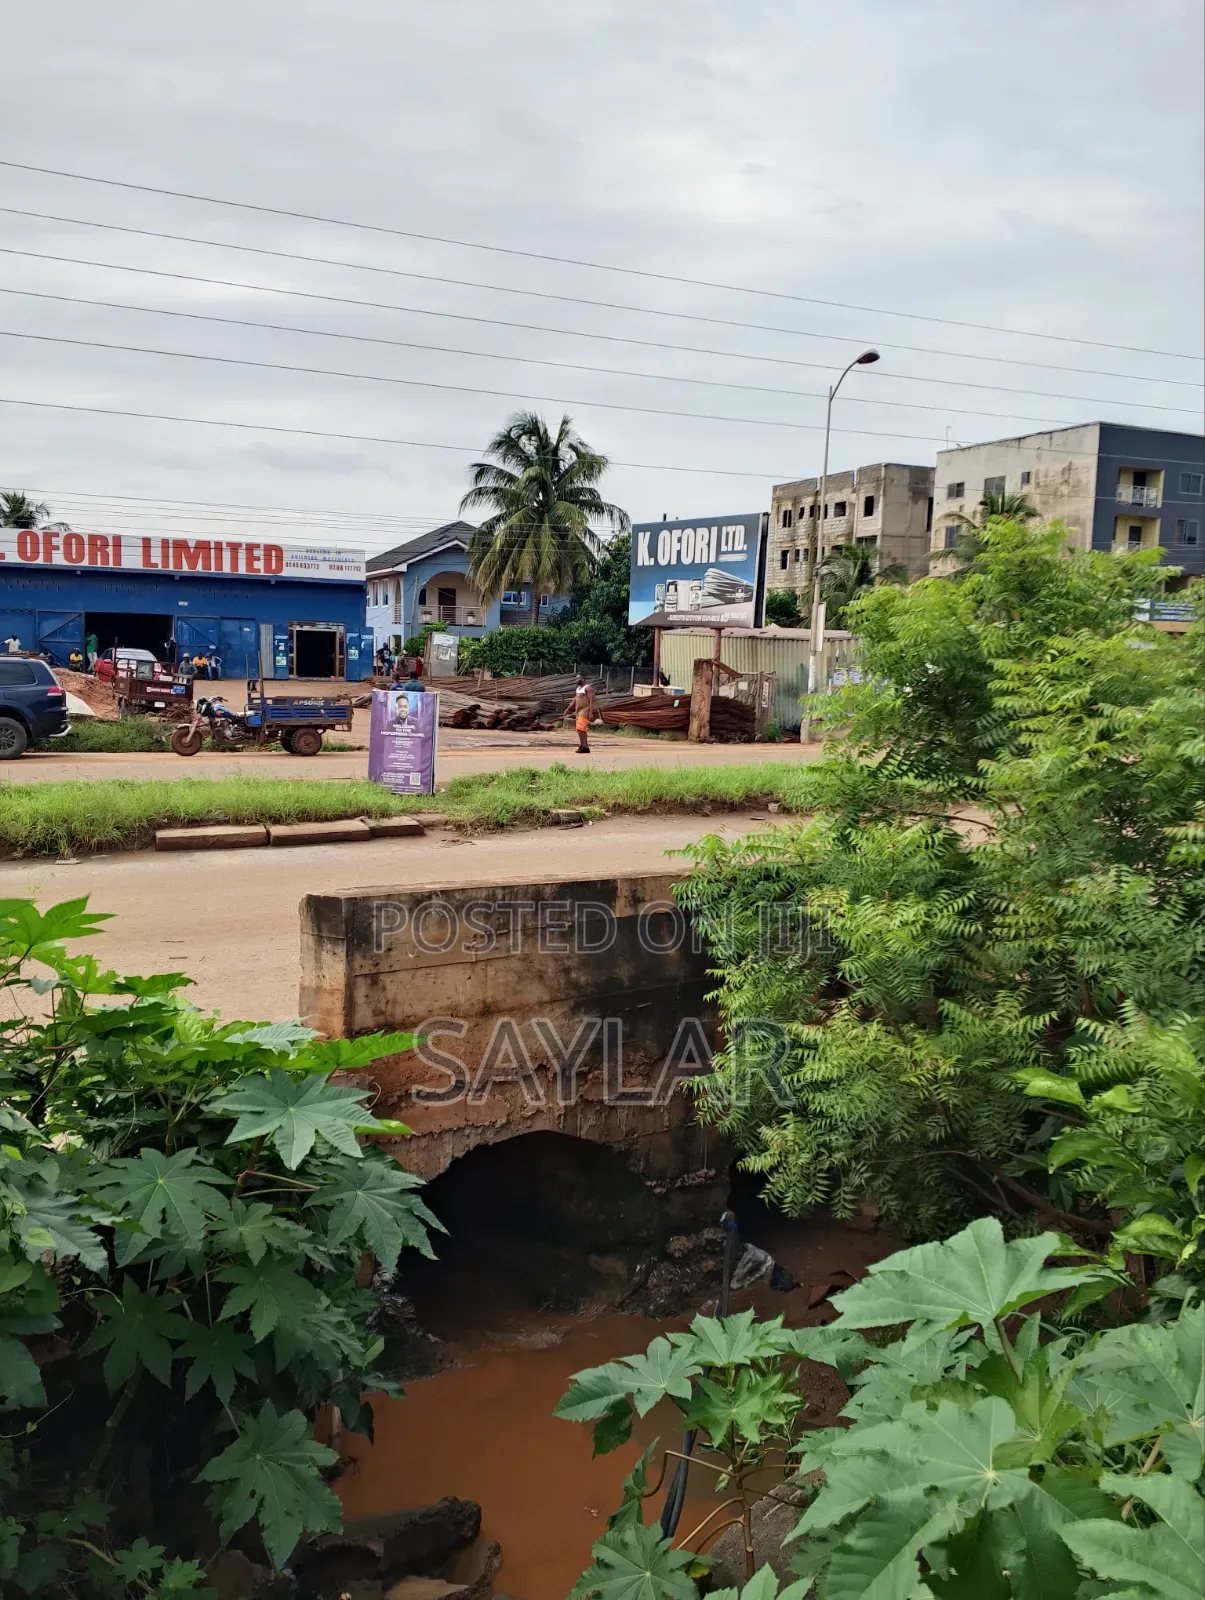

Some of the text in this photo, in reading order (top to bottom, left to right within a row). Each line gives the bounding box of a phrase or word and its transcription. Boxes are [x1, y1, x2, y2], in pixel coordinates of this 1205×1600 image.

[17, 530, 284, 575] OFORI LIMITED
[637, 524, 748, 567] K. OFORI LTD.
